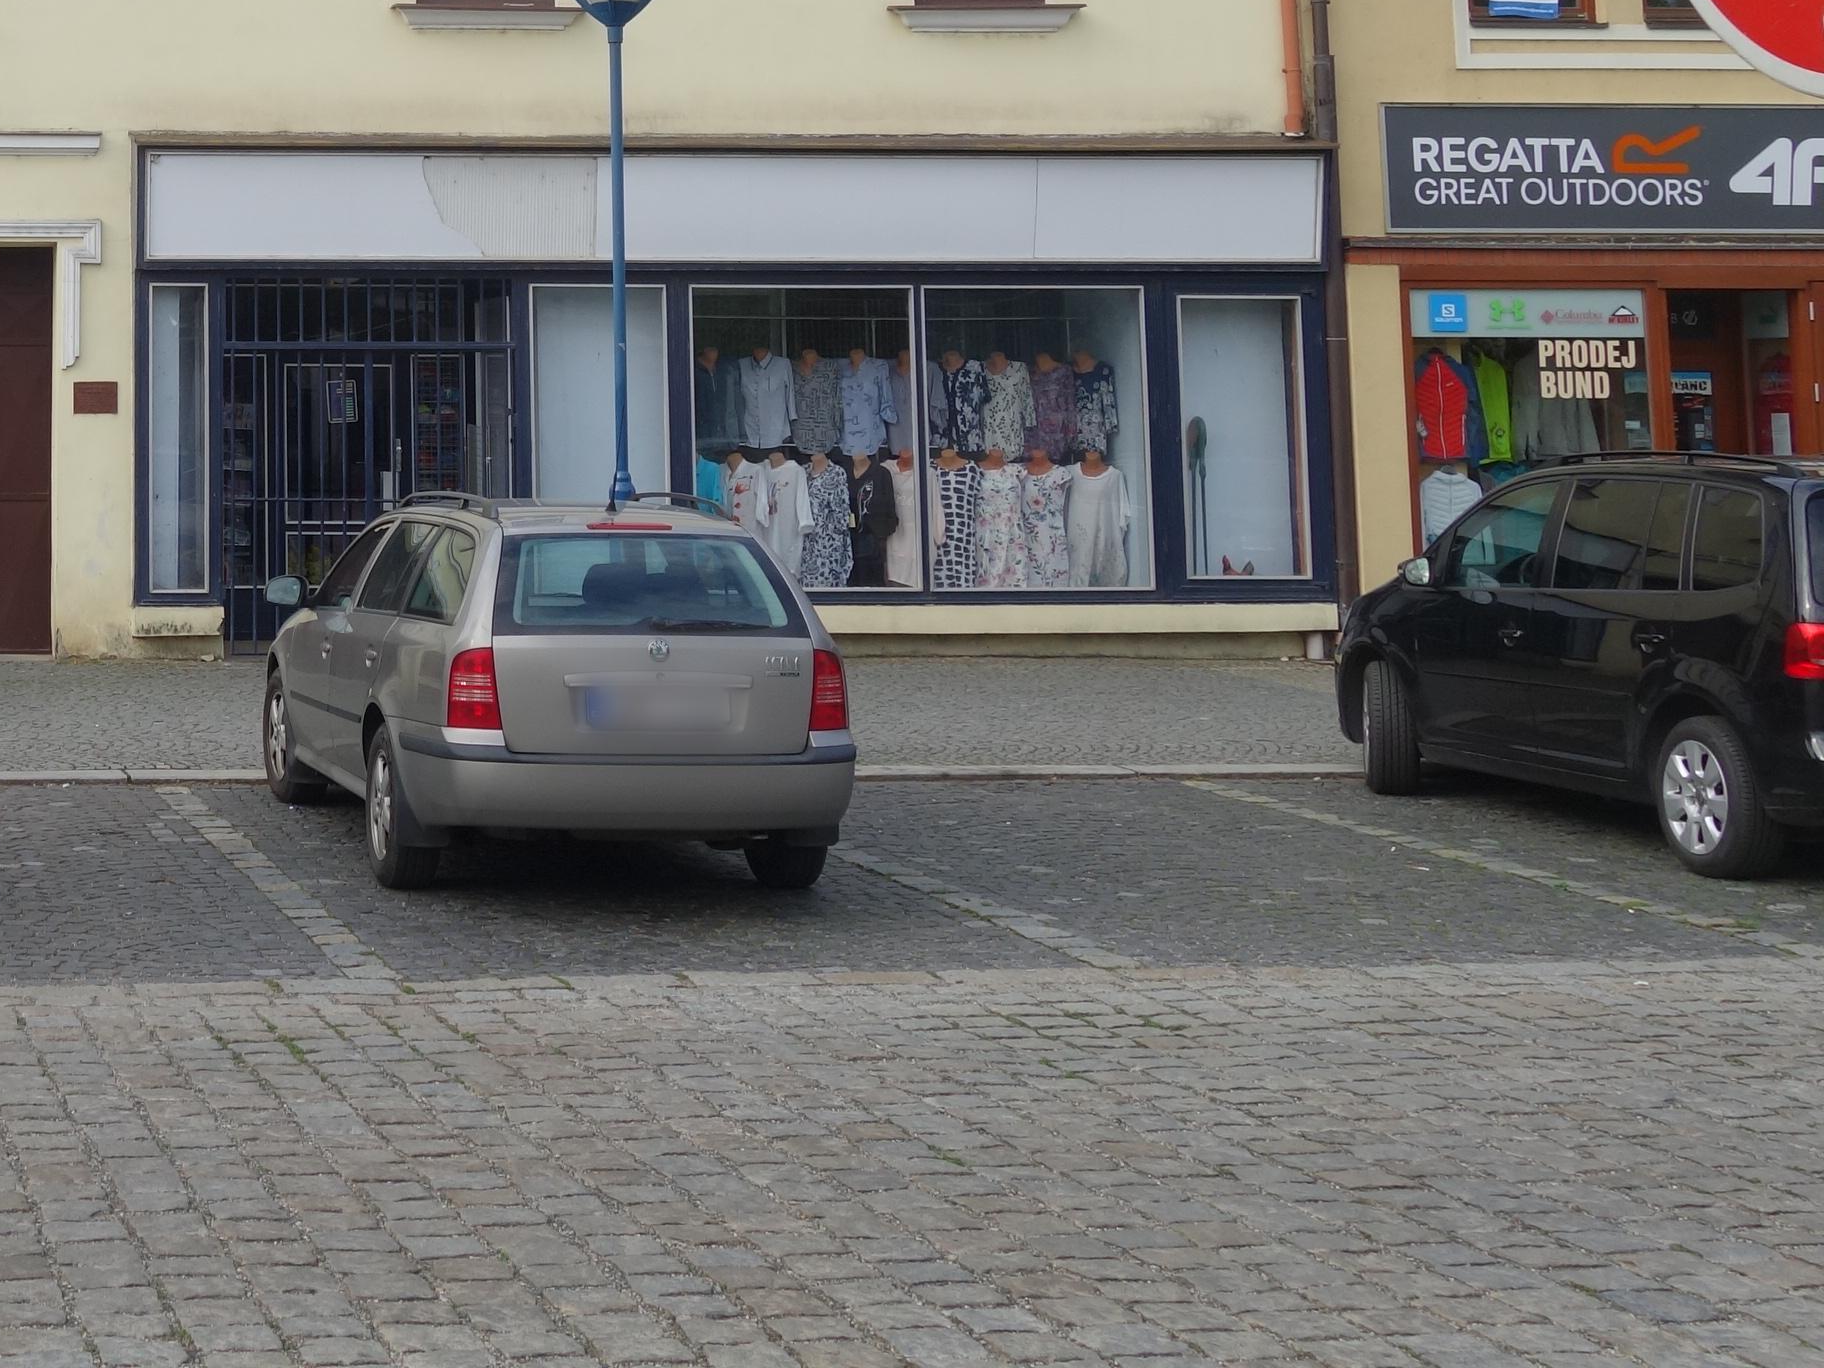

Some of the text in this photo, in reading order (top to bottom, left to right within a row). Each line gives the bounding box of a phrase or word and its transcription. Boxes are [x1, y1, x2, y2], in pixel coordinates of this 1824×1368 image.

[1412, 137, 1605, 173] REGATTA
[1414, 178, 1705, 205] GREAT OUTDOORS
[1538, 339, 1636, 368] PRODEJ
[1540, 371, 1610, 399] BUND
